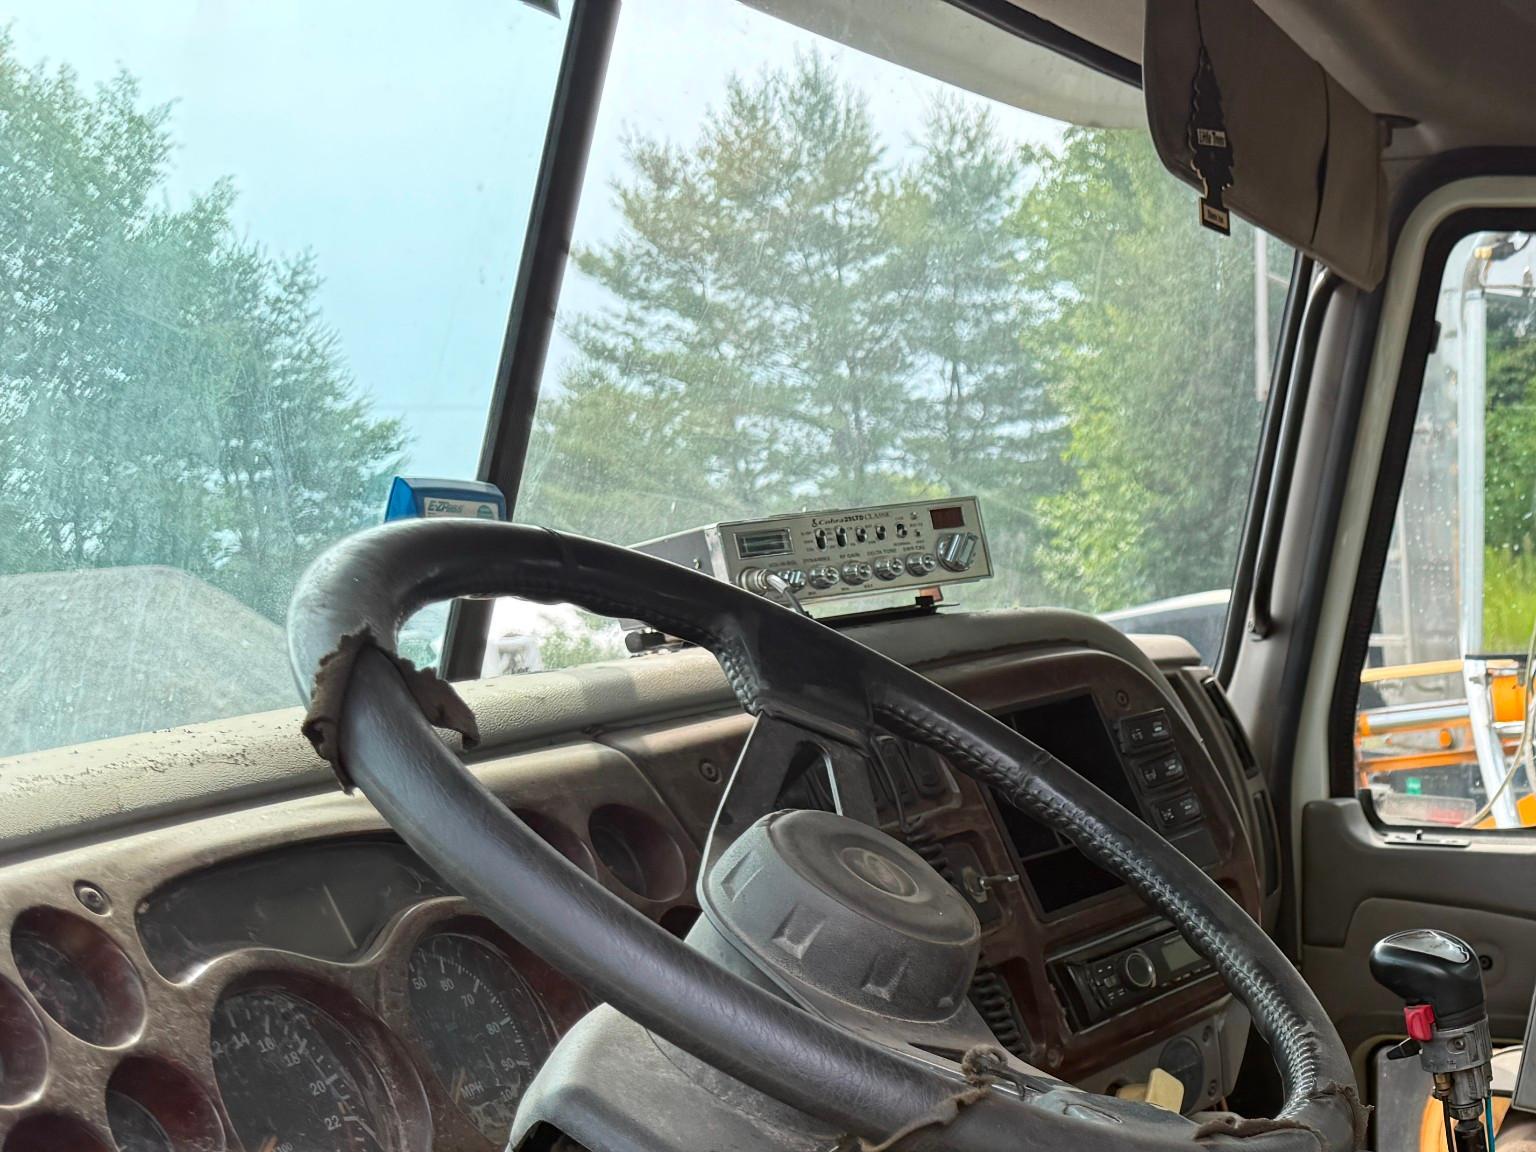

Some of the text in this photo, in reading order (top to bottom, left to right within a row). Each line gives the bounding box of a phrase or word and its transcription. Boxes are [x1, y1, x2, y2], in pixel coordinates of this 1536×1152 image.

[461, 993, 475, 1008] 70
[486, 1022, 500, 1036] 80
[231, 1031, 250, 1049] 14
[283, 1051, 301, 1067] 18
[309, 1080, 326, 1096] 20
[461, 1081, 484, 1100] MPH
[324, 1115, 342, 1131] 22
